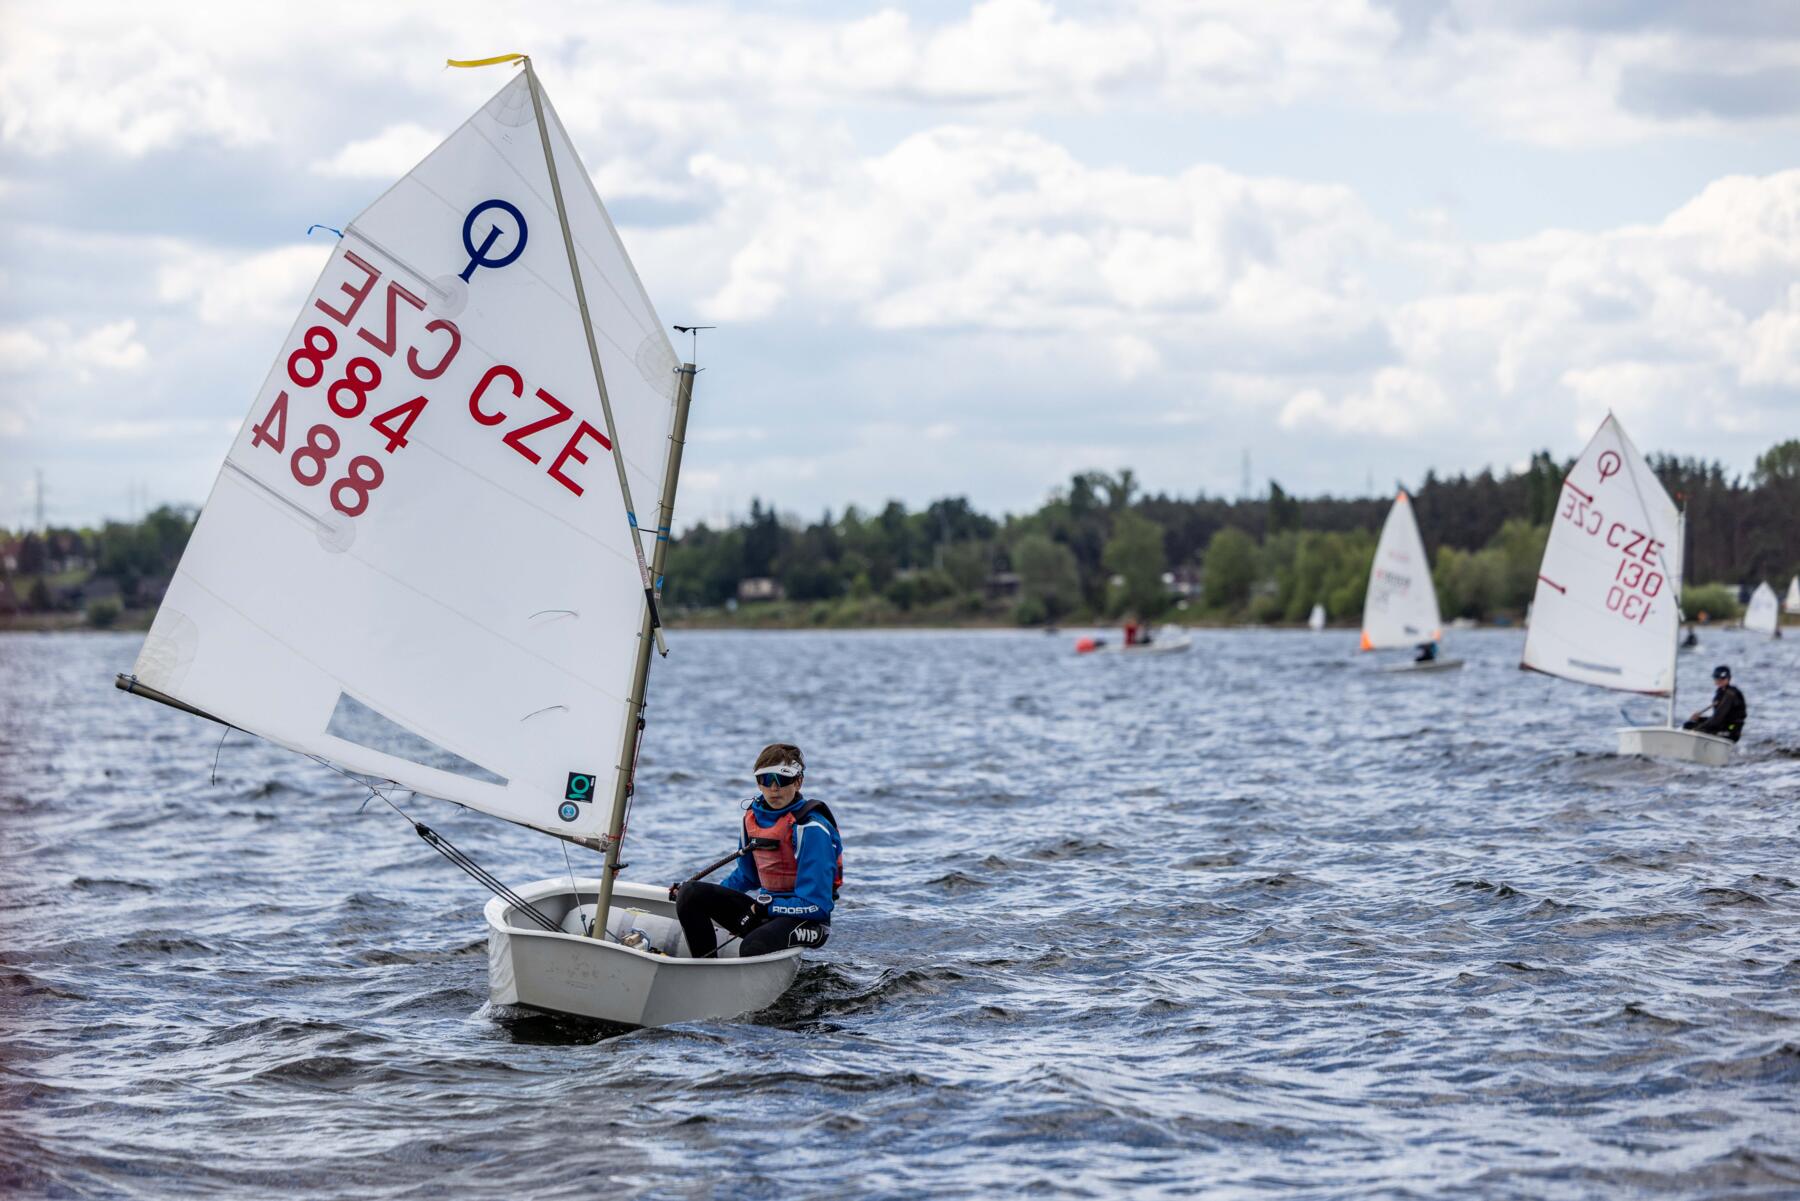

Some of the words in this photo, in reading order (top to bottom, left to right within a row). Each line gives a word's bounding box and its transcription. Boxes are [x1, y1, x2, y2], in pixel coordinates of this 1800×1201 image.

[287, 325, 429, 454] 884
[468, 364, 613, 497] CZE
[1606, 522, 1665, 567] CZE
[1615, 558, 1663, 598] 130
[794, 928, 819, 943] WIP
